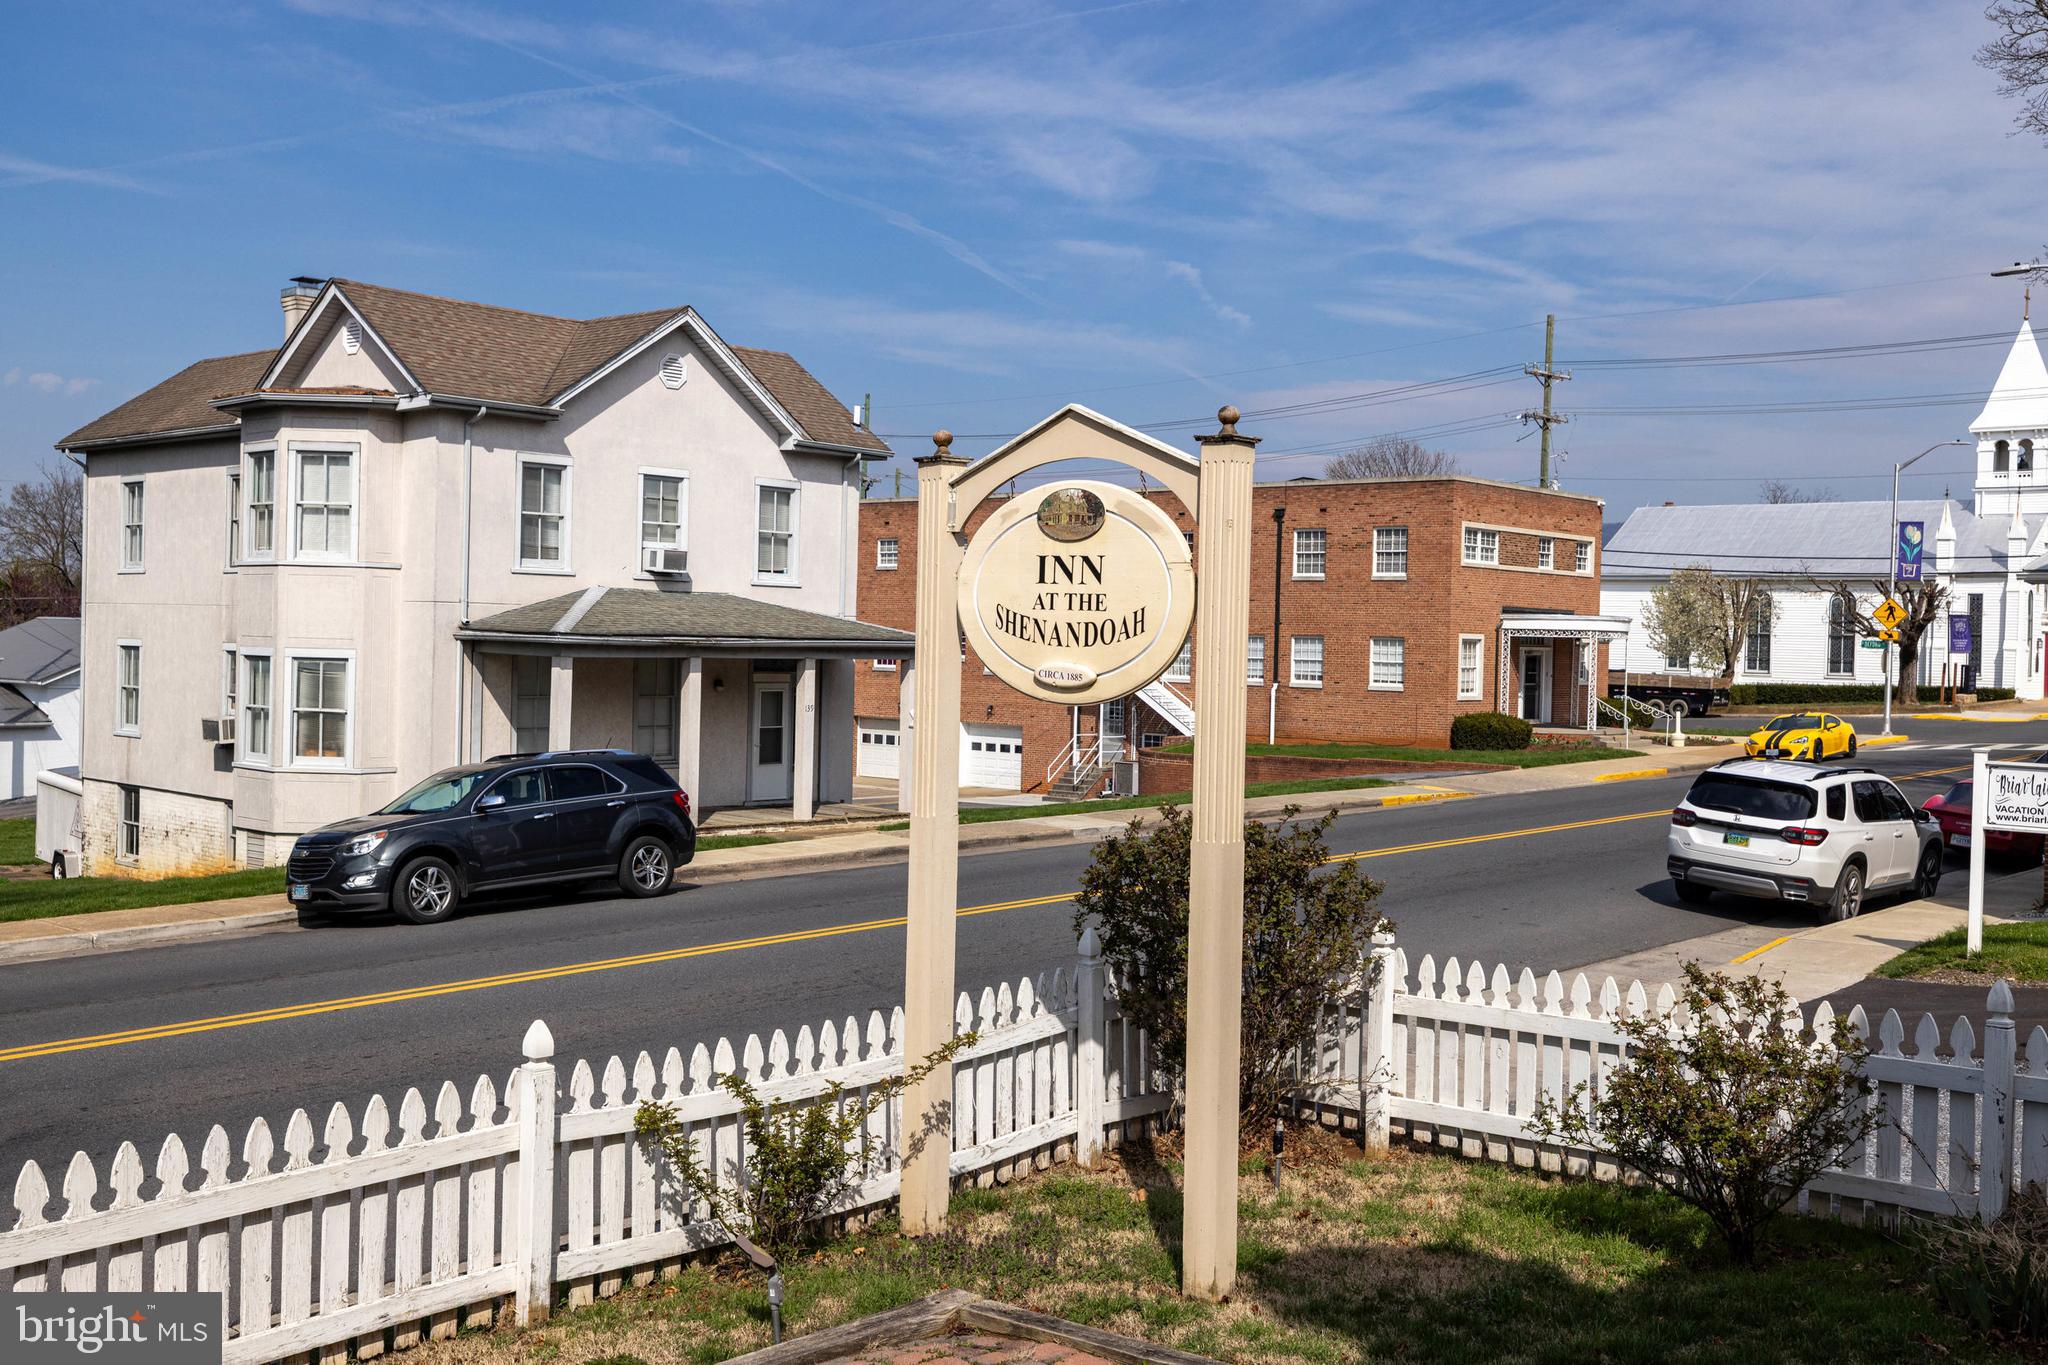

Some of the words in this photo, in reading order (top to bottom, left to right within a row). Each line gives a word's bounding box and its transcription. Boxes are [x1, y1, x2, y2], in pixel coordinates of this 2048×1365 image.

[1035, 554, 1106, 586] INN
[1032, 592, 1059, 611] AT
[1063, 593, 1108, 612] THE
[995, 602, 1148, 649] SHENANDOAH
[1038, 669, 1065, 680] CIRCA
[1067, 672, 1083, 682] 1885
[1995, 805, 2044, 815] VACATION
[1996, 815, 2048, 824] www.briarl
